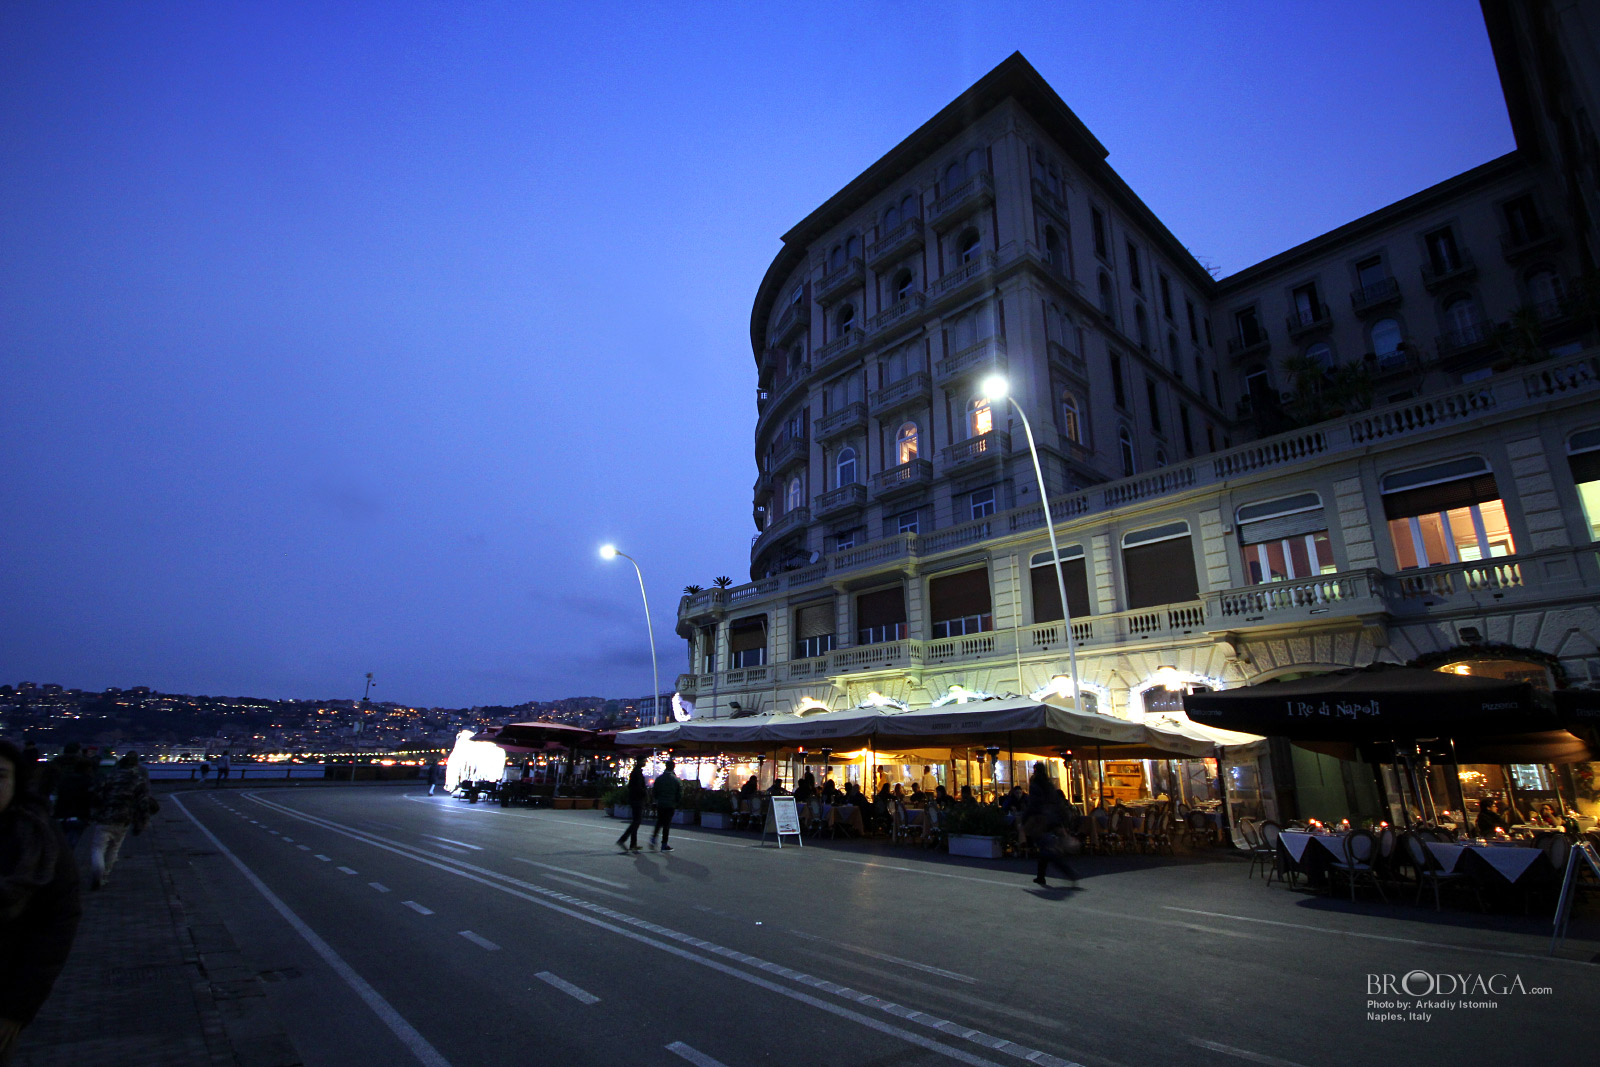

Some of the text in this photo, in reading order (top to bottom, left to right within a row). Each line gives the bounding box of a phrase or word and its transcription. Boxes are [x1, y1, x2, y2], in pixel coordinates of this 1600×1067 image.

[1297, 701, 1314, 718] Re
[1318, 701, 1331, 716] di
[1335, 699, 1382, 720] Napoli
